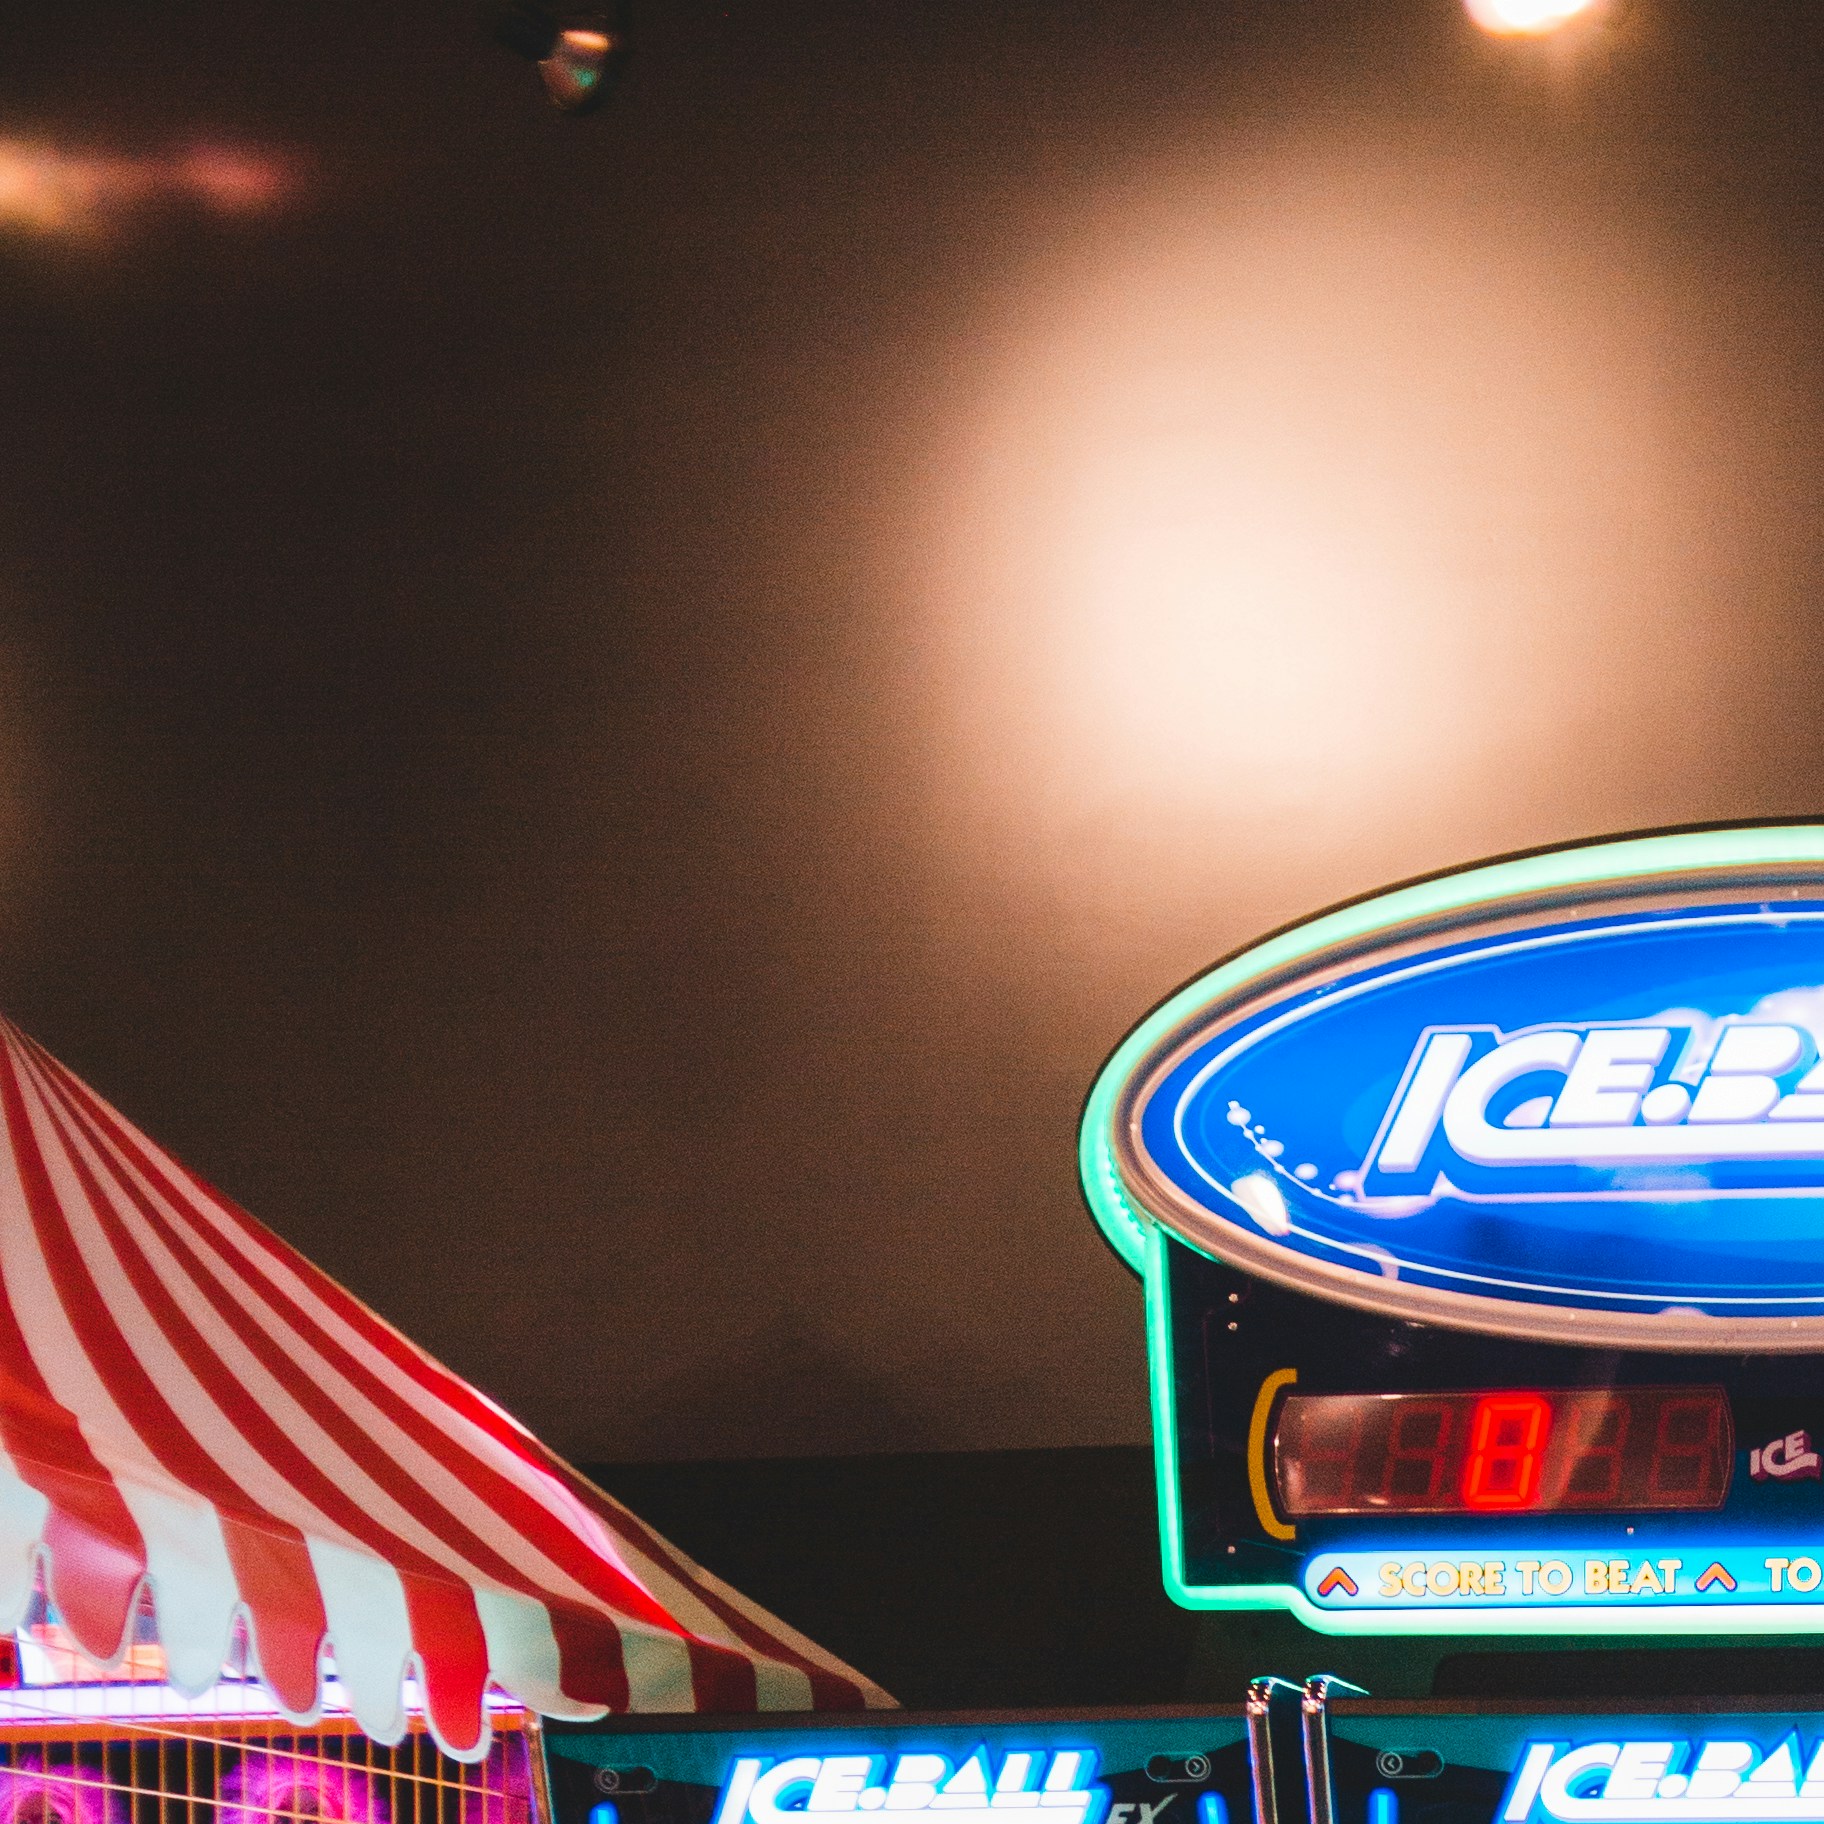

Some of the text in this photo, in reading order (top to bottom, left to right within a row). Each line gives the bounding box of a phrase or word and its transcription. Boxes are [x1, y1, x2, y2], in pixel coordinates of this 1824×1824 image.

[1750, 1430, 1822, 1480] ICE
[1378, 1558, 1683, 1597] SCORE TO BEAT
[1764, 1556, 1824, 1592] TO
